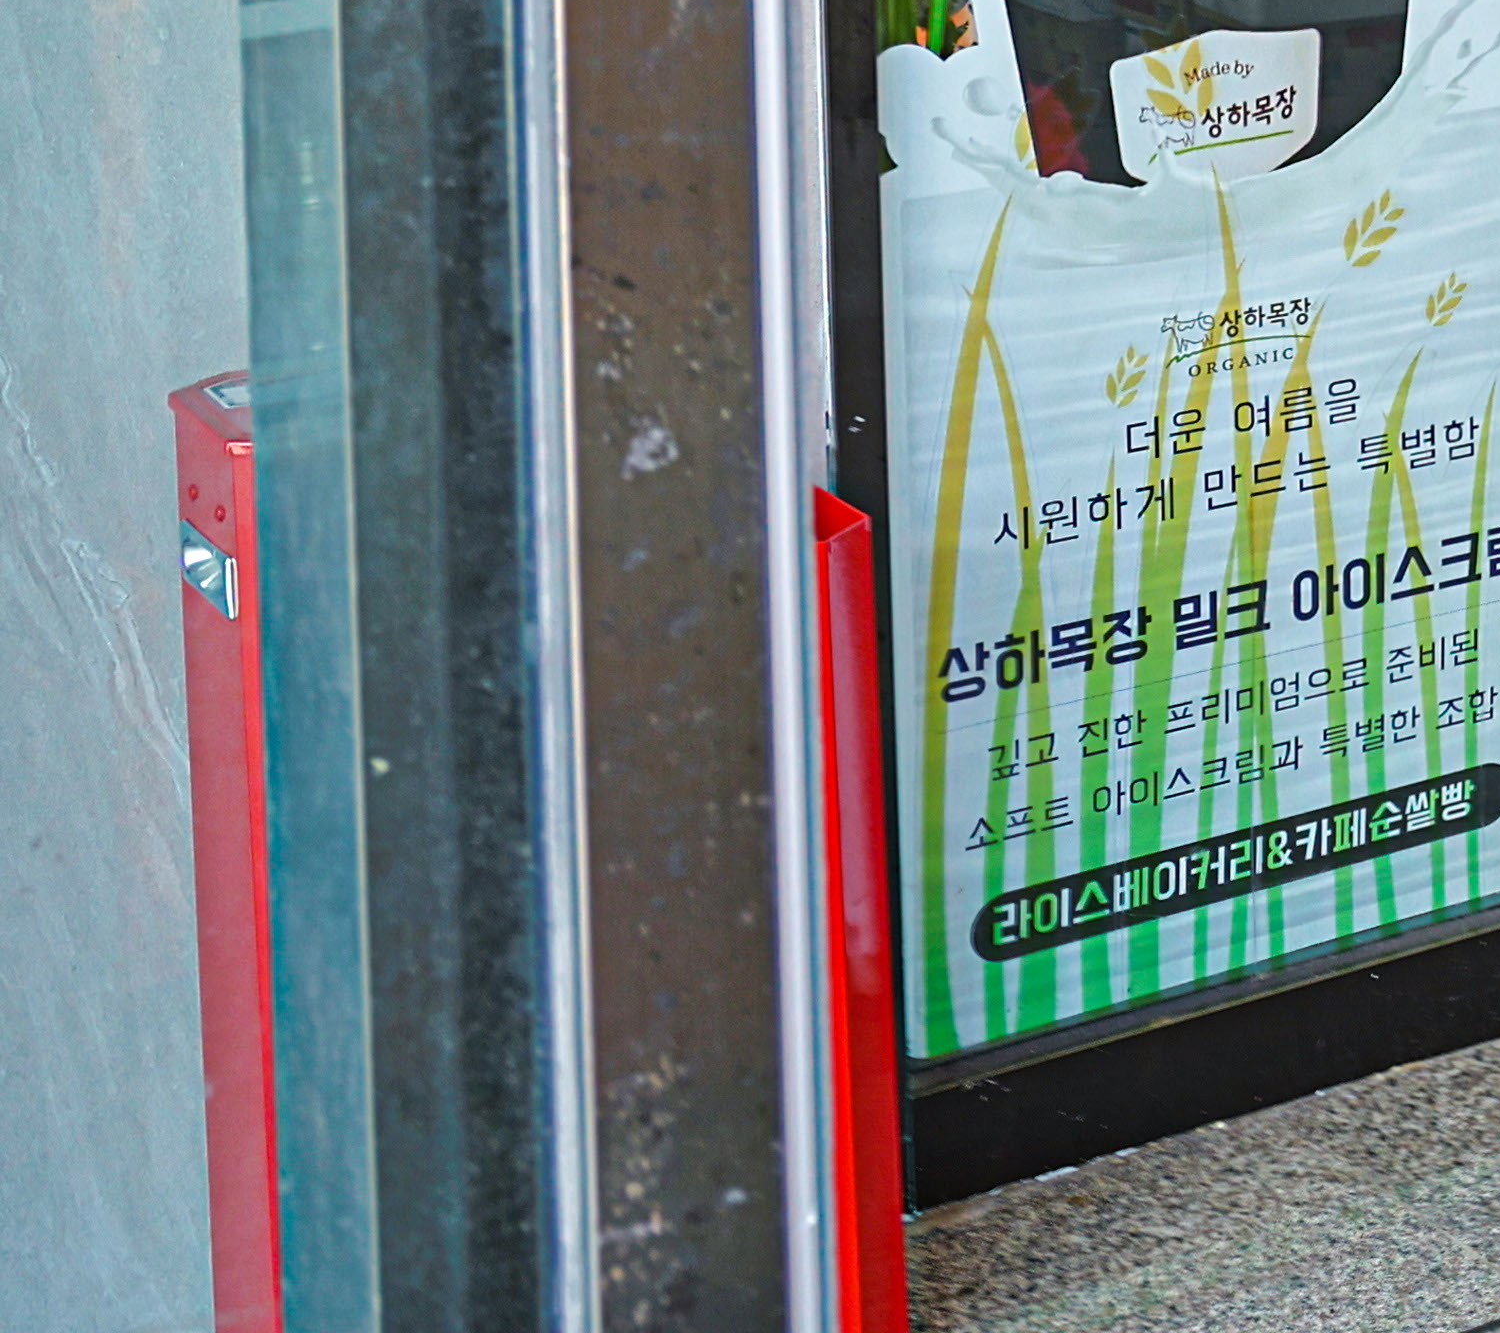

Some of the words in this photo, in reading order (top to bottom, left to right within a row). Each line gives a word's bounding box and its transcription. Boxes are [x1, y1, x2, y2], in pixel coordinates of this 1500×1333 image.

[1182, 61, 1230, 87] Made
[1231, 60, 1255, 78] by
[1201, 85, 1297, 138] 상하목장
[1218, 297, 1312, 338] 상하목장
[1187, 346, 1295, 378] ORGANIC
[1125, 407, 1207, 460] 더운
[1233, 377, 1362, 435] 여름을
[993, 476, 1177, 551] 시원하게
[1203, 449, 1332, 513] 만드는
[1356, 415, 1480, 476] 특별함
[937, 607, 1153, 703] 상하목장
[1172, 580, 1271, 651] 밀크
[987, 732, 1060, 783] 깊고
[1077, 711, 1147, 758] 진한
[1163, 657, 1372, 736] 프리미엄으로
[1385, 627, 1481, 685] 준비된
[964, 796, 1074, 853] 소프트
[1091, 736, 1303, 815] 아이스크림과
[1318, 708, 1422, 759] 특별한
[1435, 688, 1500, 731] 조합
